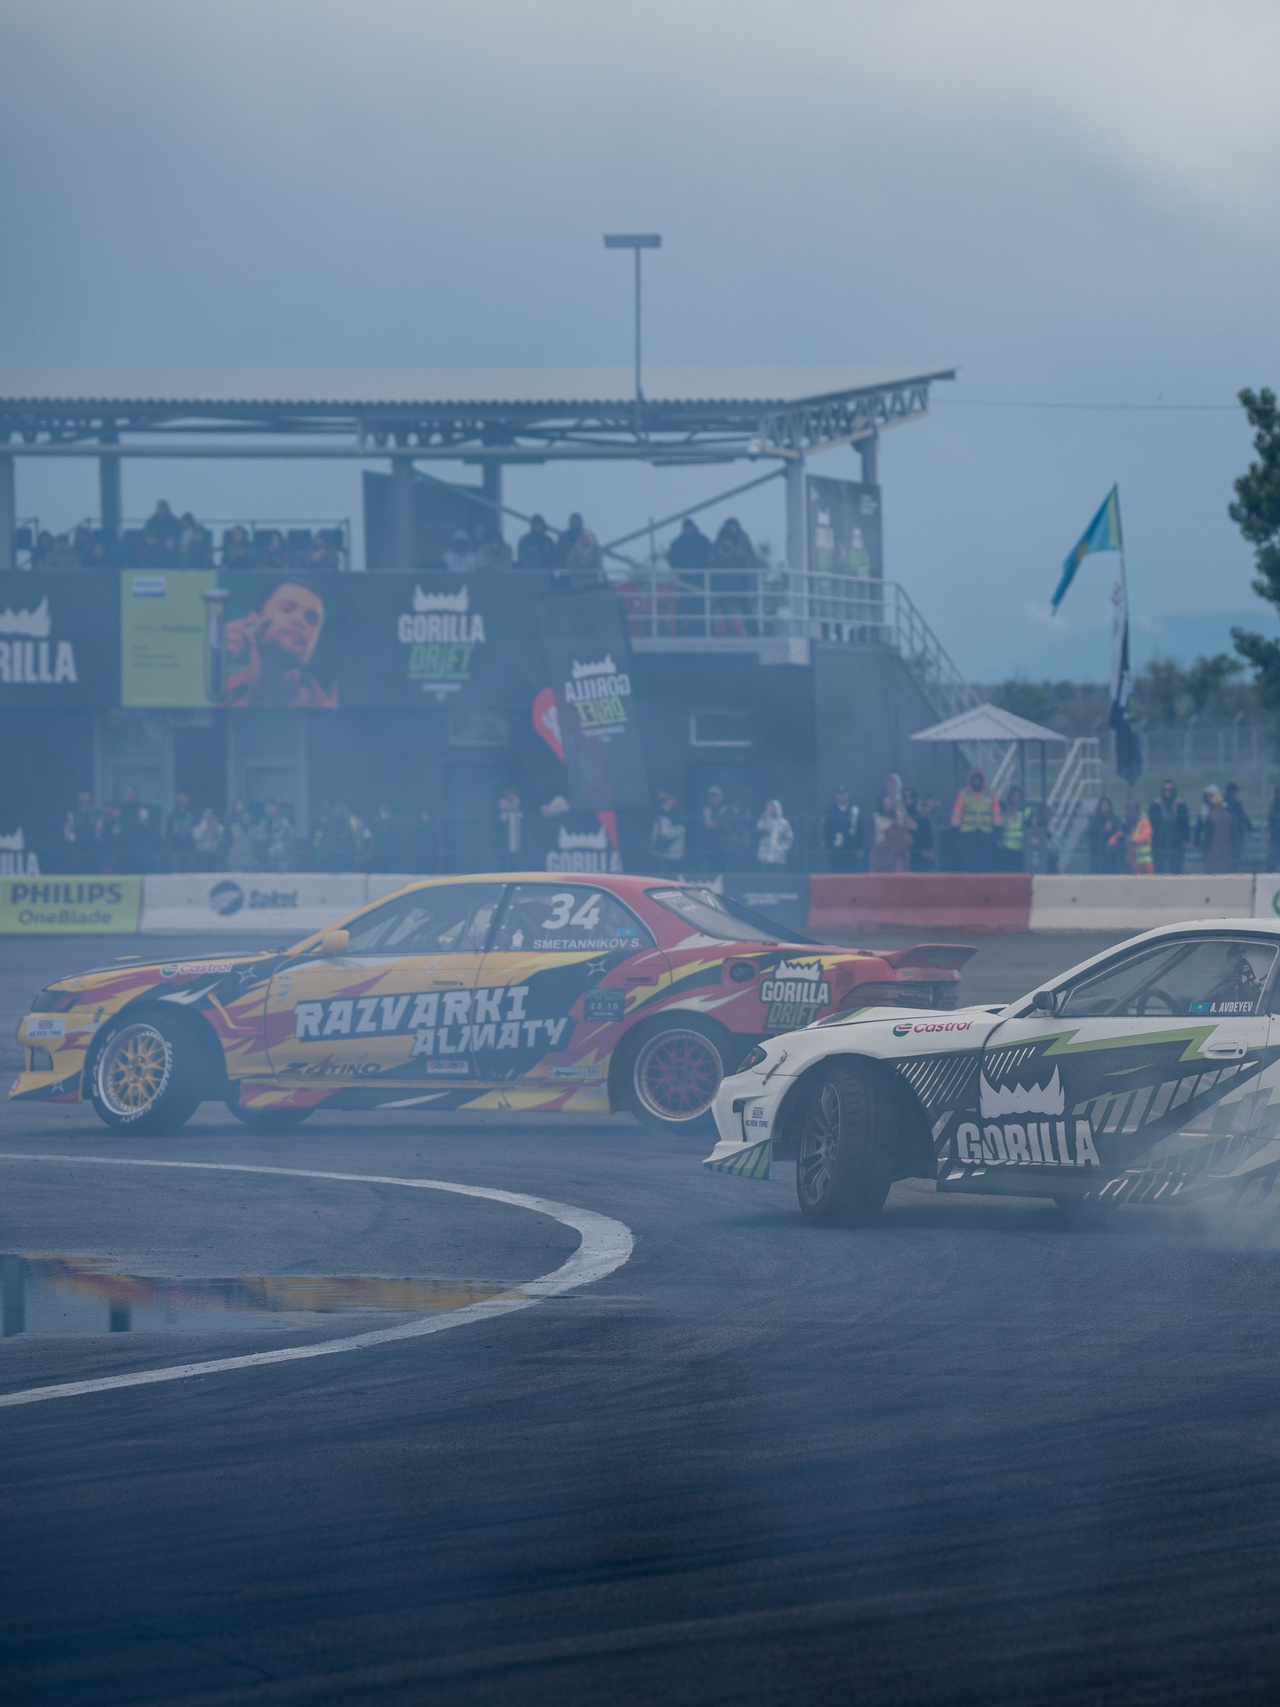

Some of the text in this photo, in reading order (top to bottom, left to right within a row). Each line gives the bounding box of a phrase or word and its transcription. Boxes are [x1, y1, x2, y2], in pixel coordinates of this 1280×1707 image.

[398, 613, 486, 643] GORILLA
[546, 850, 624, 873] GORILLA
[11, 882, 123, 904] PHILIPS
[18, 908, 112, 925] OneBlade
[541, 893, 602, 930] 34
[533, 937, 643, 950] SMETANNIKOV S.
[179, 962, 233, 976] Castrol
[761, 980, 829, 1005] GORILLA
[294, 985, 529, 1038] RAZVARKI
[1209, 1001, 1254, 1013] A. AVDEYEV
[411, 1017, 568, 1056] ALMATY
[912, 1020, 975, 1034] Castrol
[758, 1120, 769, 1128] TIRE
[956, 1120, 1100, 1166] GORILLA
